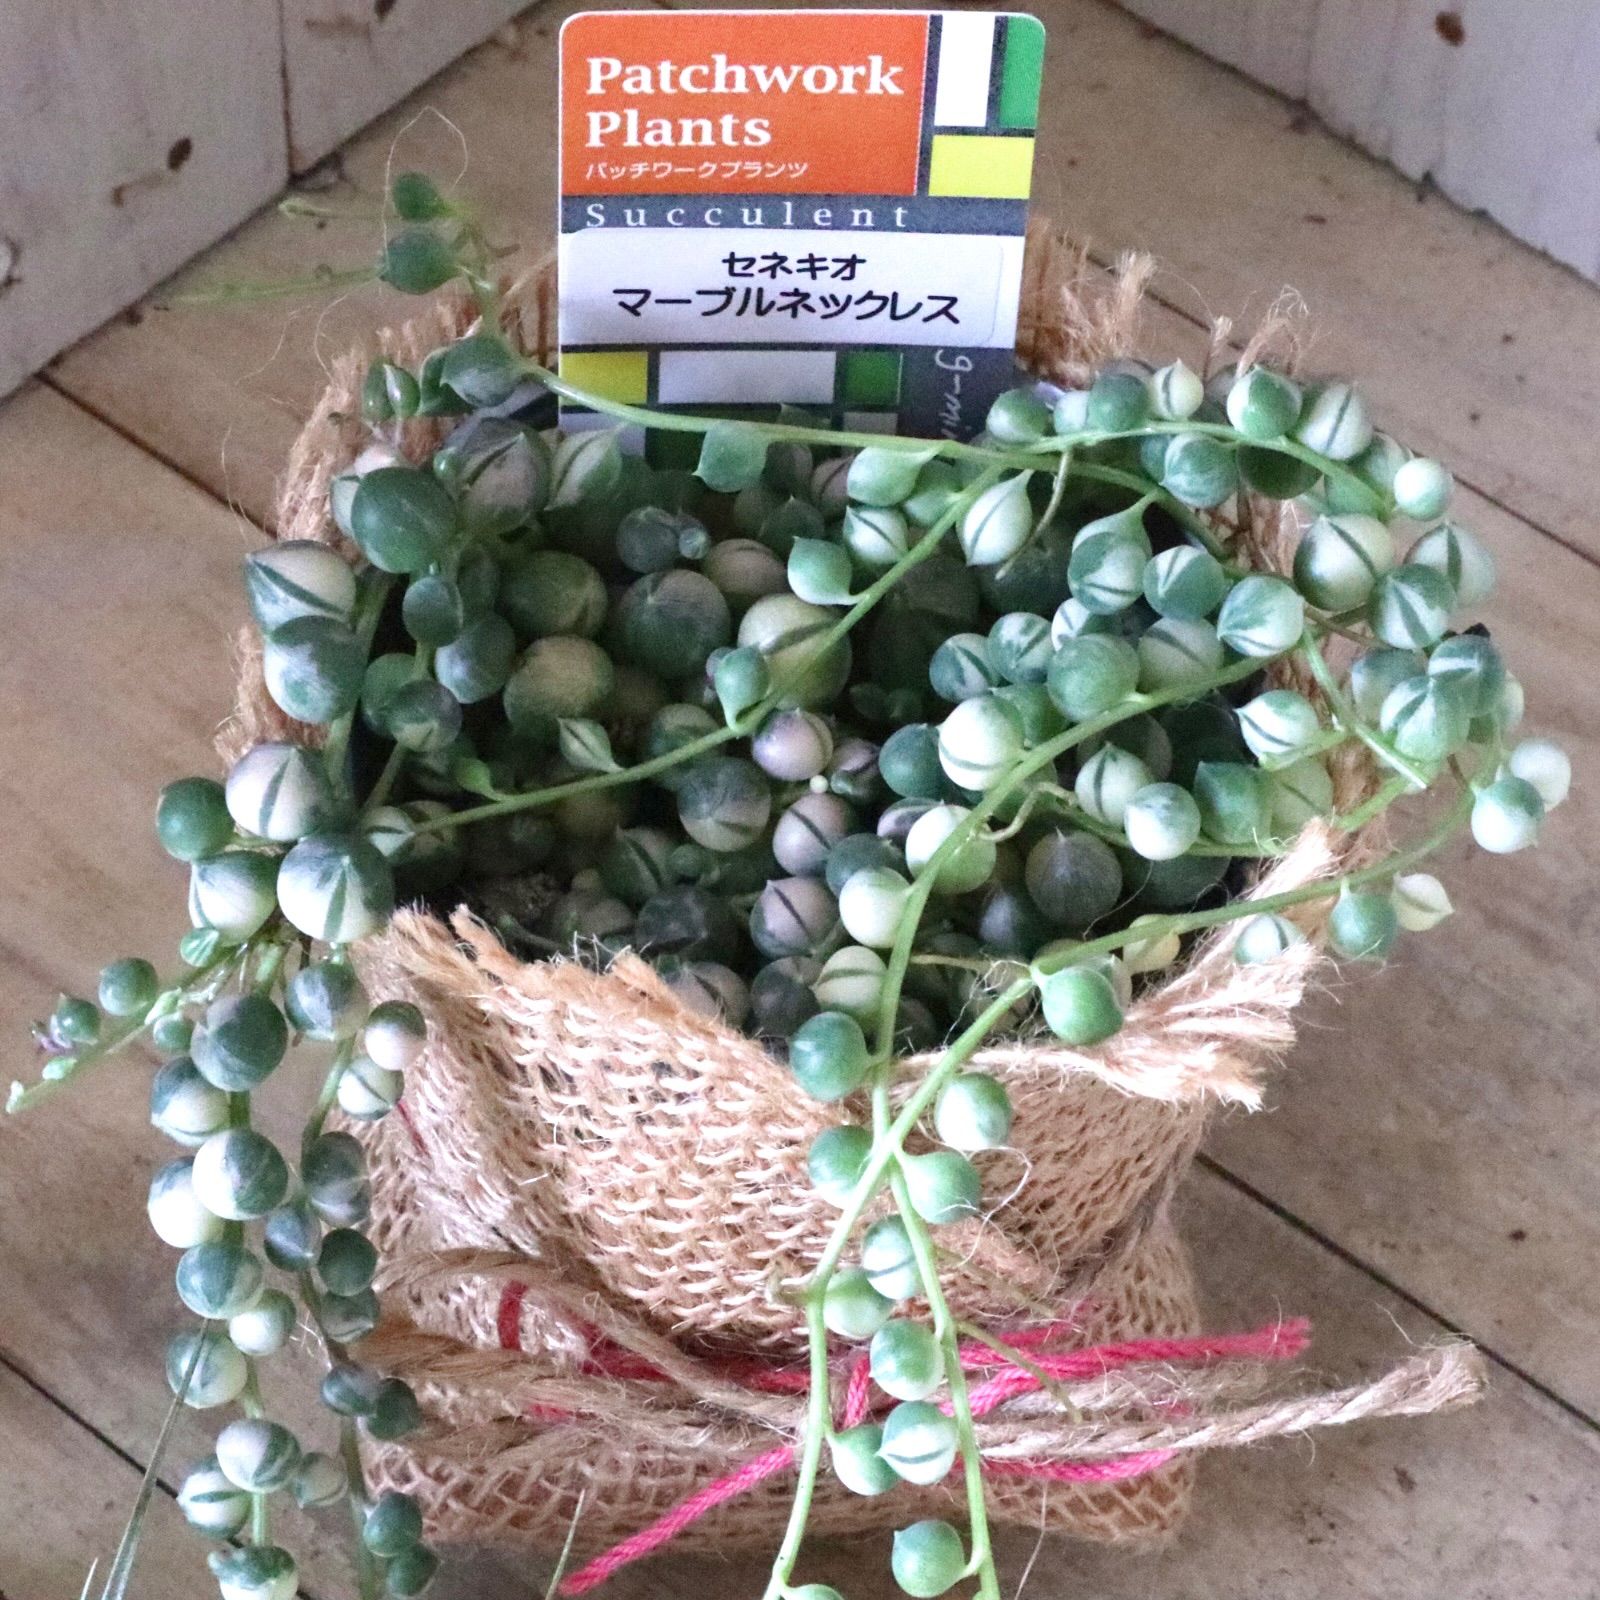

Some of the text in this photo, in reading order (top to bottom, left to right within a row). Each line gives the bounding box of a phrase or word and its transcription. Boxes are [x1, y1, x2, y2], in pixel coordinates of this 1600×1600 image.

[586, 54, 904, 97] Patchwork
[585, 109, 772, 148] Plants
[586, 201, 910, 228] Succulent
[721, 251, 867, 281] セネキオ
[612, 287, 960, 325] マーブルネックレス
